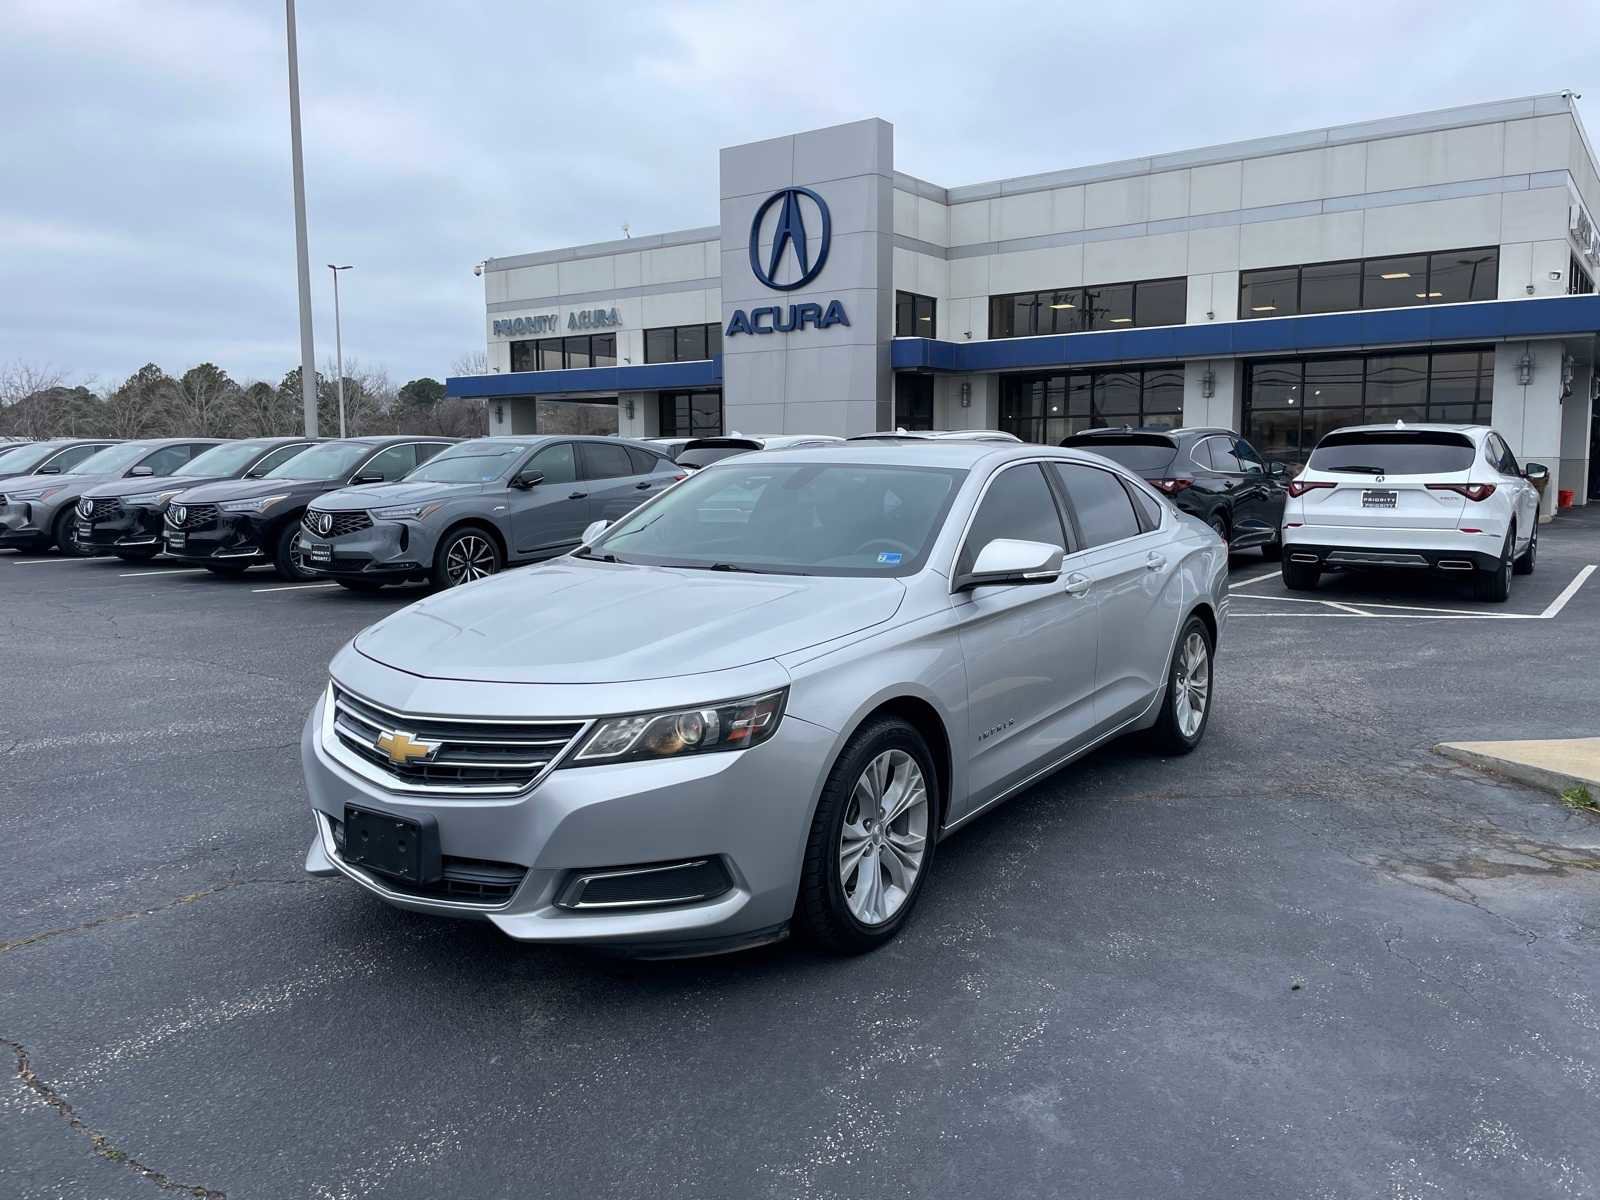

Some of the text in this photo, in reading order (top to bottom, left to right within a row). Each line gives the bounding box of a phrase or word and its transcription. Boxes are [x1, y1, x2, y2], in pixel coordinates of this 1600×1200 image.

[493, 306, 623, 336] PRIORITY ACURA
[725, 299, 850, 336] ACURA
